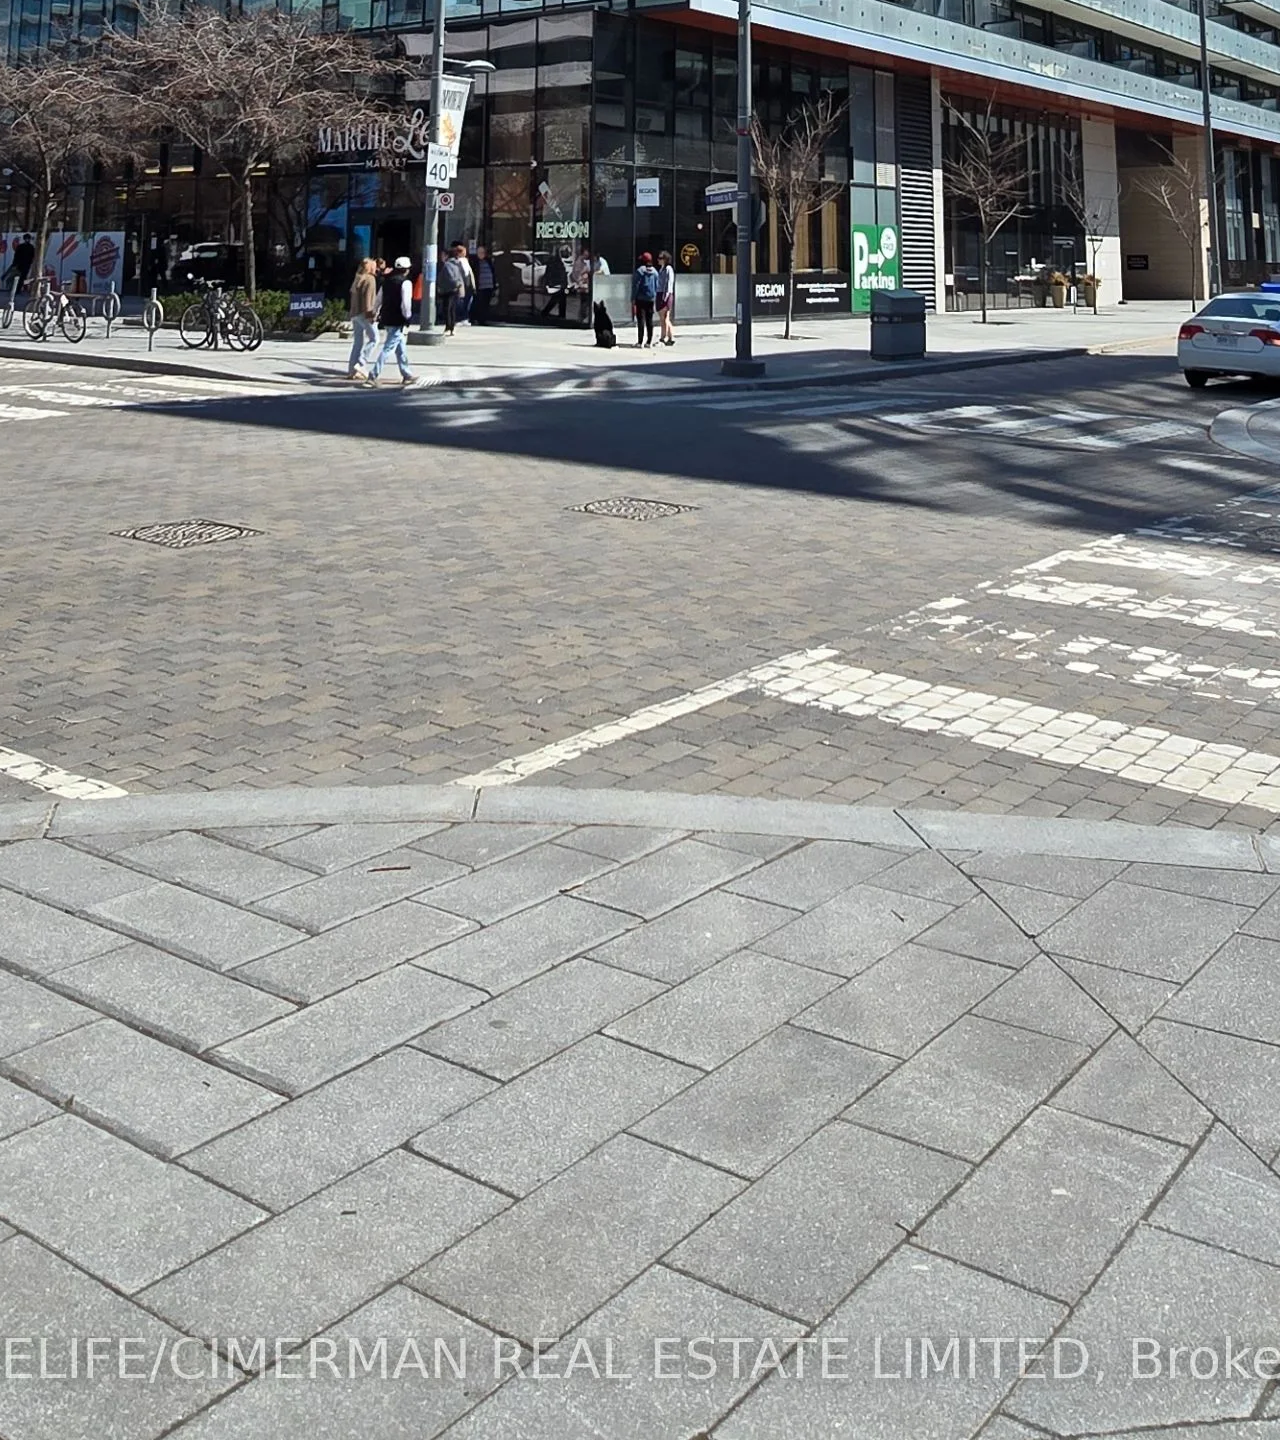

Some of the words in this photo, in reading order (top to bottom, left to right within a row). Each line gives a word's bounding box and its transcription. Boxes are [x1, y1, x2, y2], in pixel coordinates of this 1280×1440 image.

[365, 157, 407, 168] MARKET
[429, 163, 448, 181] 40
[535, 220, 590, 239] REGION
[853, 231, 896, 290] Parking
[755, 283, 785, 297] REGION
